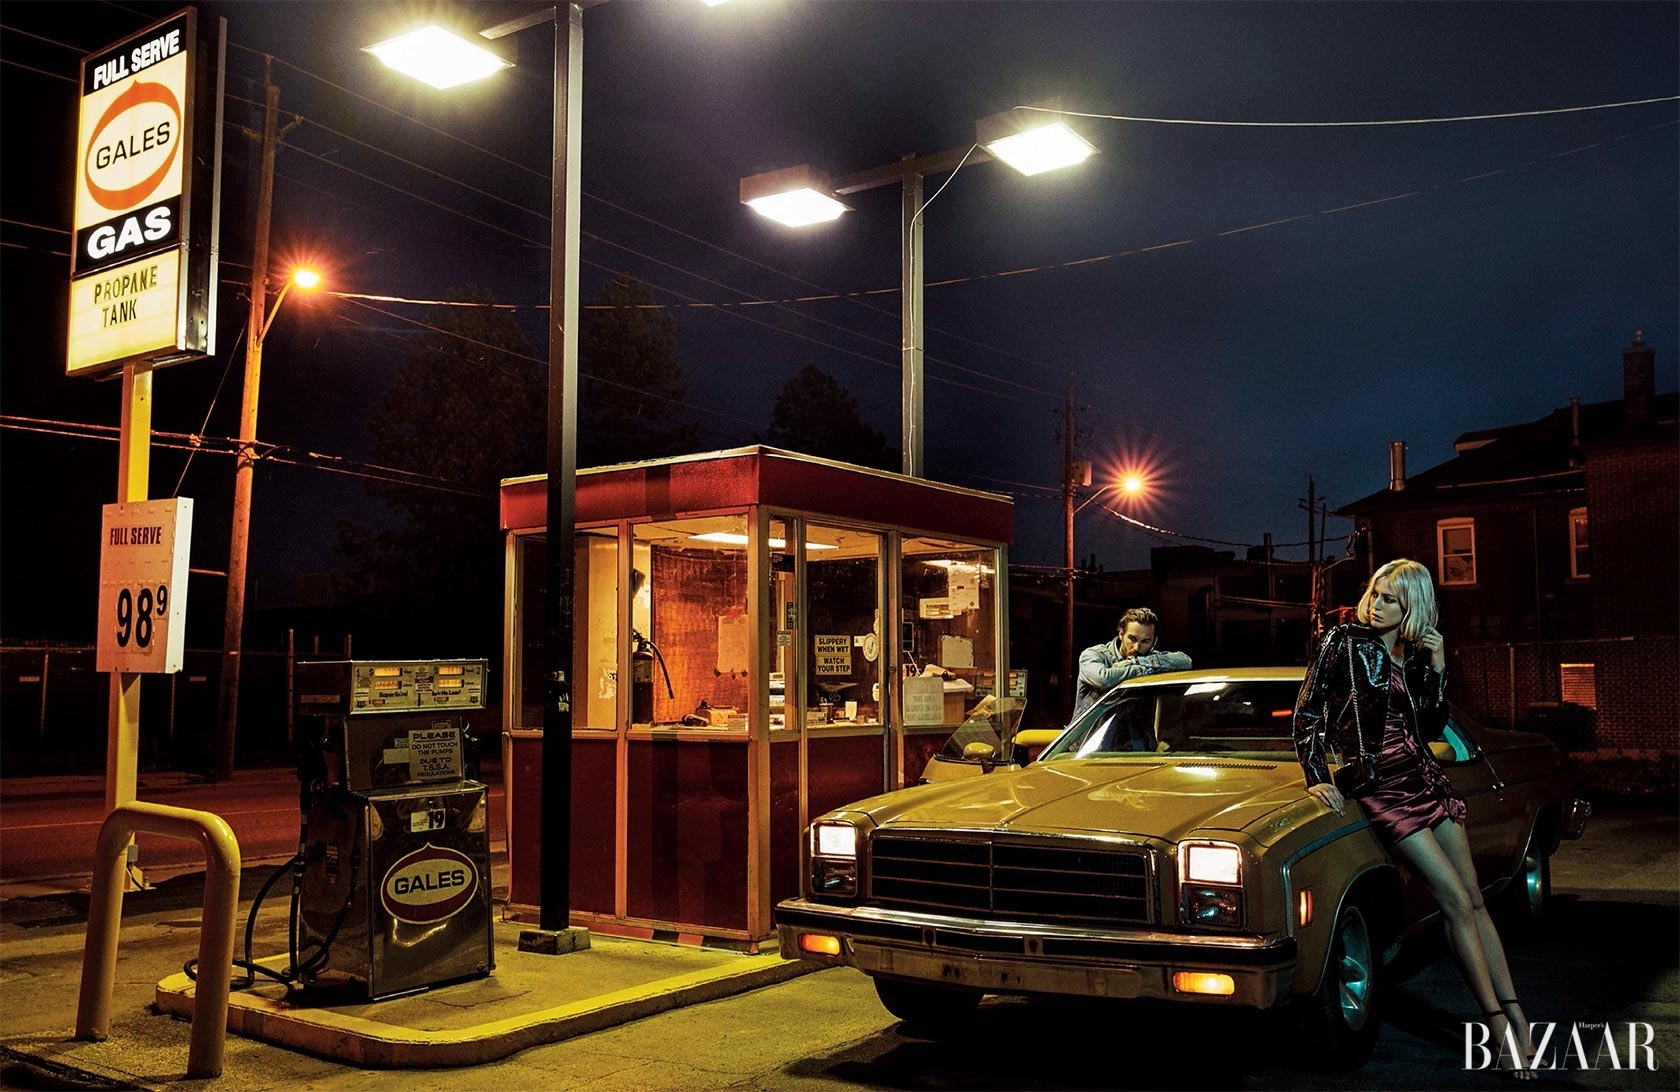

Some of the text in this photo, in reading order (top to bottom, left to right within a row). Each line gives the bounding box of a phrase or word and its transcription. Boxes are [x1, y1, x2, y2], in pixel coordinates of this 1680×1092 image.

[93, 29, 180, 90] FULL SERVE
[96, 121, 170, 170] GALES
[87, 206, 171, 259] GAS
[94, 265, 158, 304] PROPANE
[102, 299, 137, 328] TANK
[110, 526, 162, 545] FULL SERVE
[476, 666, 481, 675] 2
[905, 664, 917, 677] 19
[413, 731, 455, 739] PLEASE
[428, 811, 444, 829] 19
[394, 869, 465, 895] GALES
